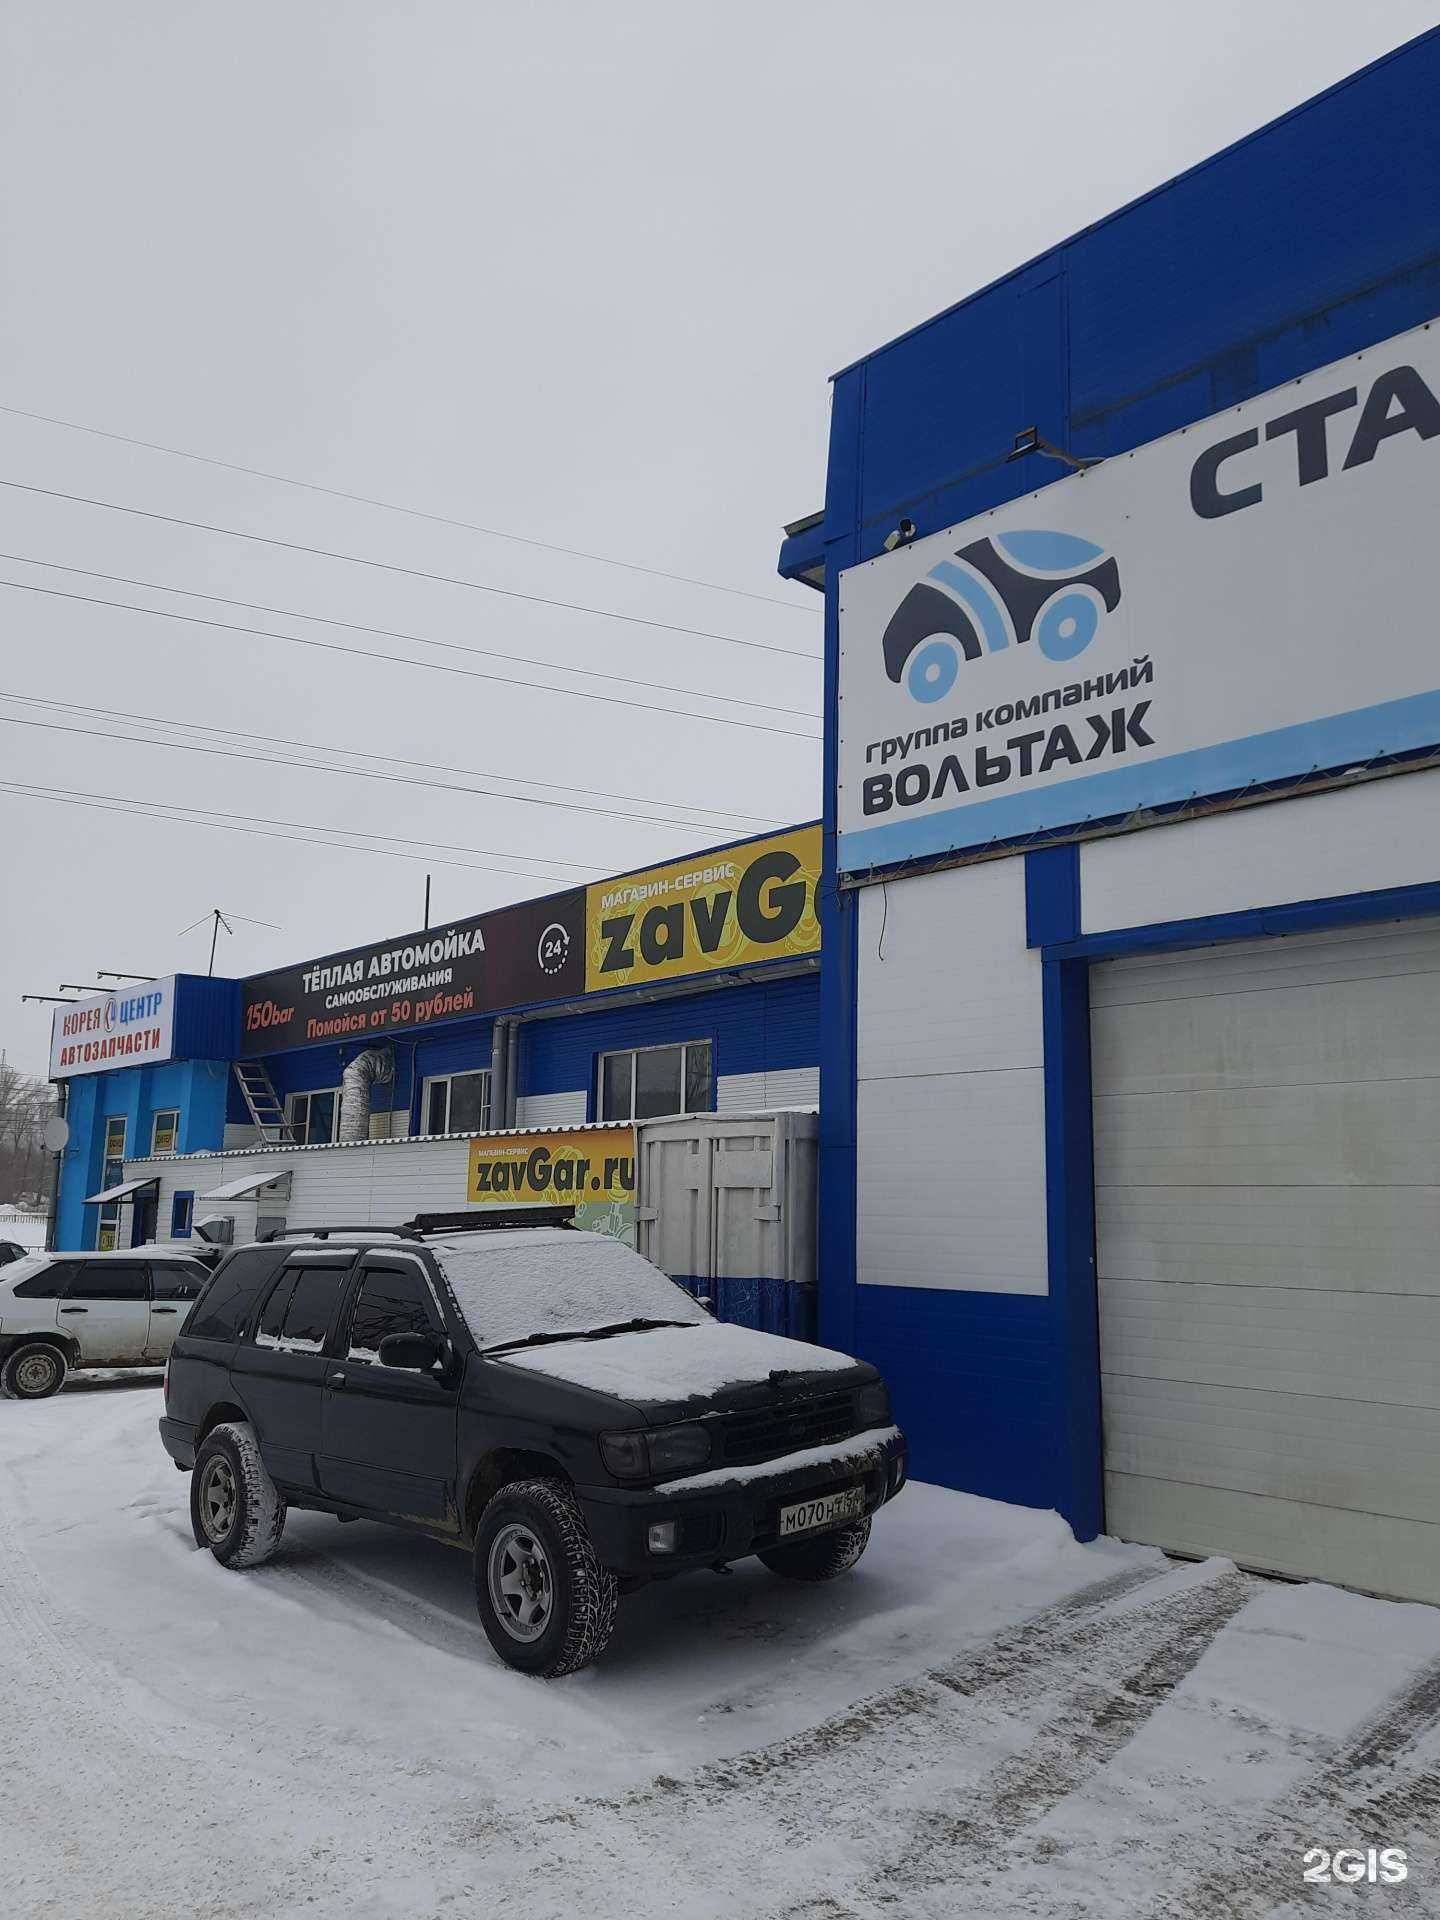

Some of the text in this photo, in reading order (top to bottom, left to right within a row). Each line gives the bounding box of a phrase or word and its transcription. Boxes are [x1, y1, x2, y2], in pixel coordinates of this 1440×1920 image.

[865, 654, 1154, 764] группа компаний
[862, 700, 1155, 815] ВОЛЬТАЖ
[601, 863, 735, 909] МАГАЗИН-СЕРВИС
[600, 851, 822, 973] zavG
[302, 928, 486, 994] ТЁПЛАЯ АВТОМОЙКА
[545, 940, 561, 957] 24
[325, 968, 453, 1009] САМООБСЛУЖИВАНИЯ
[63, 1008, 101, 1036] КОРЕЯ
[120, 992, 162, 1026] ЦЕНТР
[306, 985, 474, 1039] Помойся от 50 рублей
[60, 1028, 160, 1067] АВТОЗАПЧАСТИ
[476, 1147, 635, 1191] zavGar.ru
